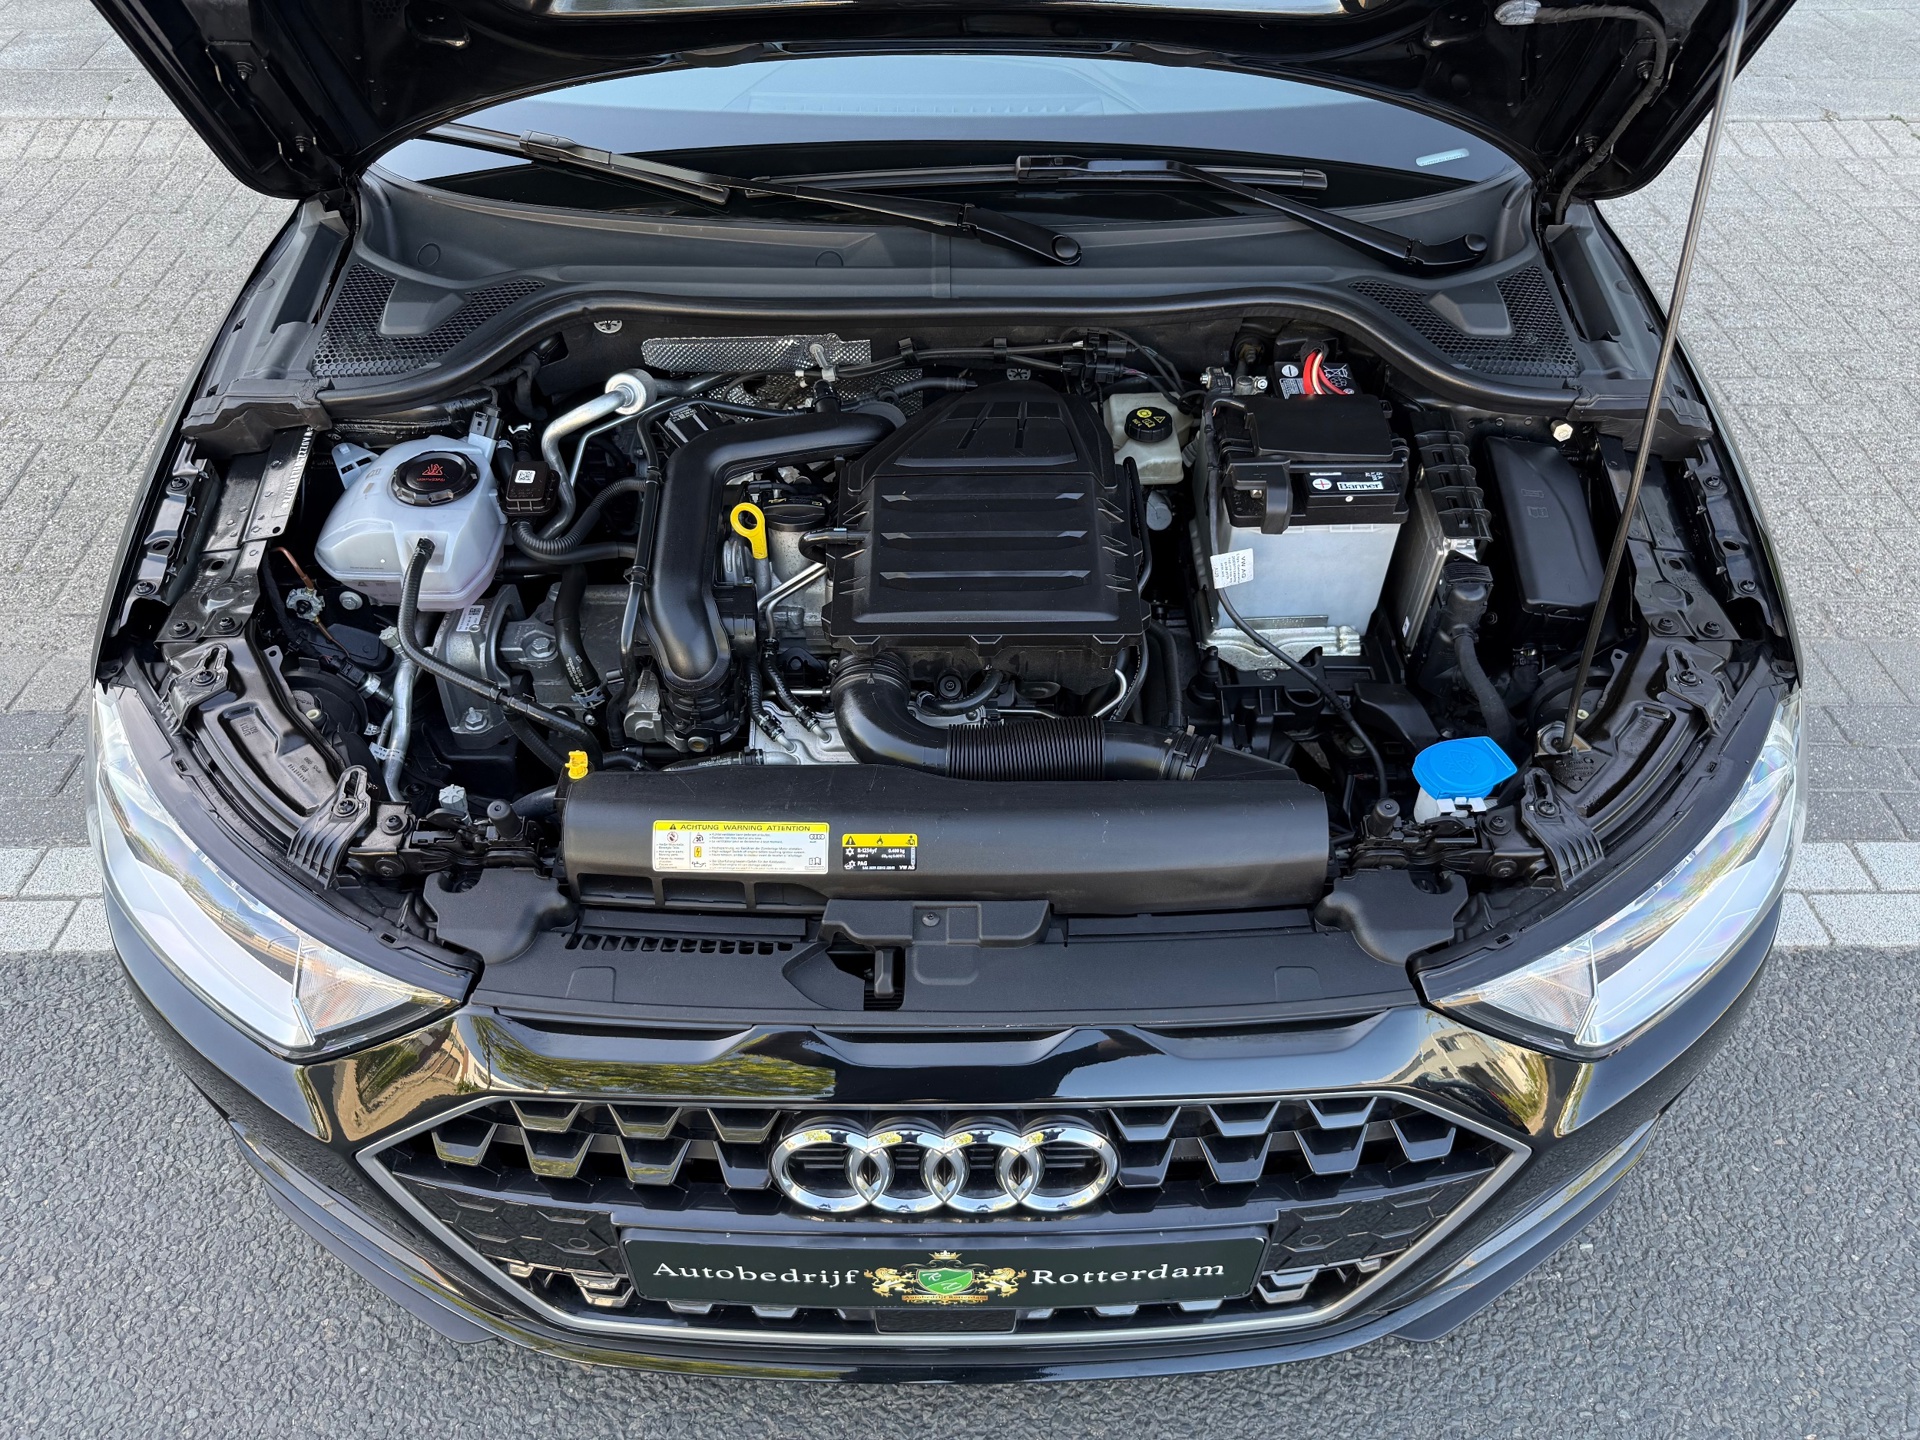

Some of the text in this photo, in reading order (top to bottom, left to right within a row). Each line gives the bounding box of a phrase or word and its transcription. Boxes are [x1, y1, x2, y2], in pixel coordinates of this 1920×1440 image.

[1338, 482, 1381, 490] Banner
[1240, 555, 1247, 579] VW AG
[653, 1262, 1225, 1288] Autobedrijf Rotterdam
